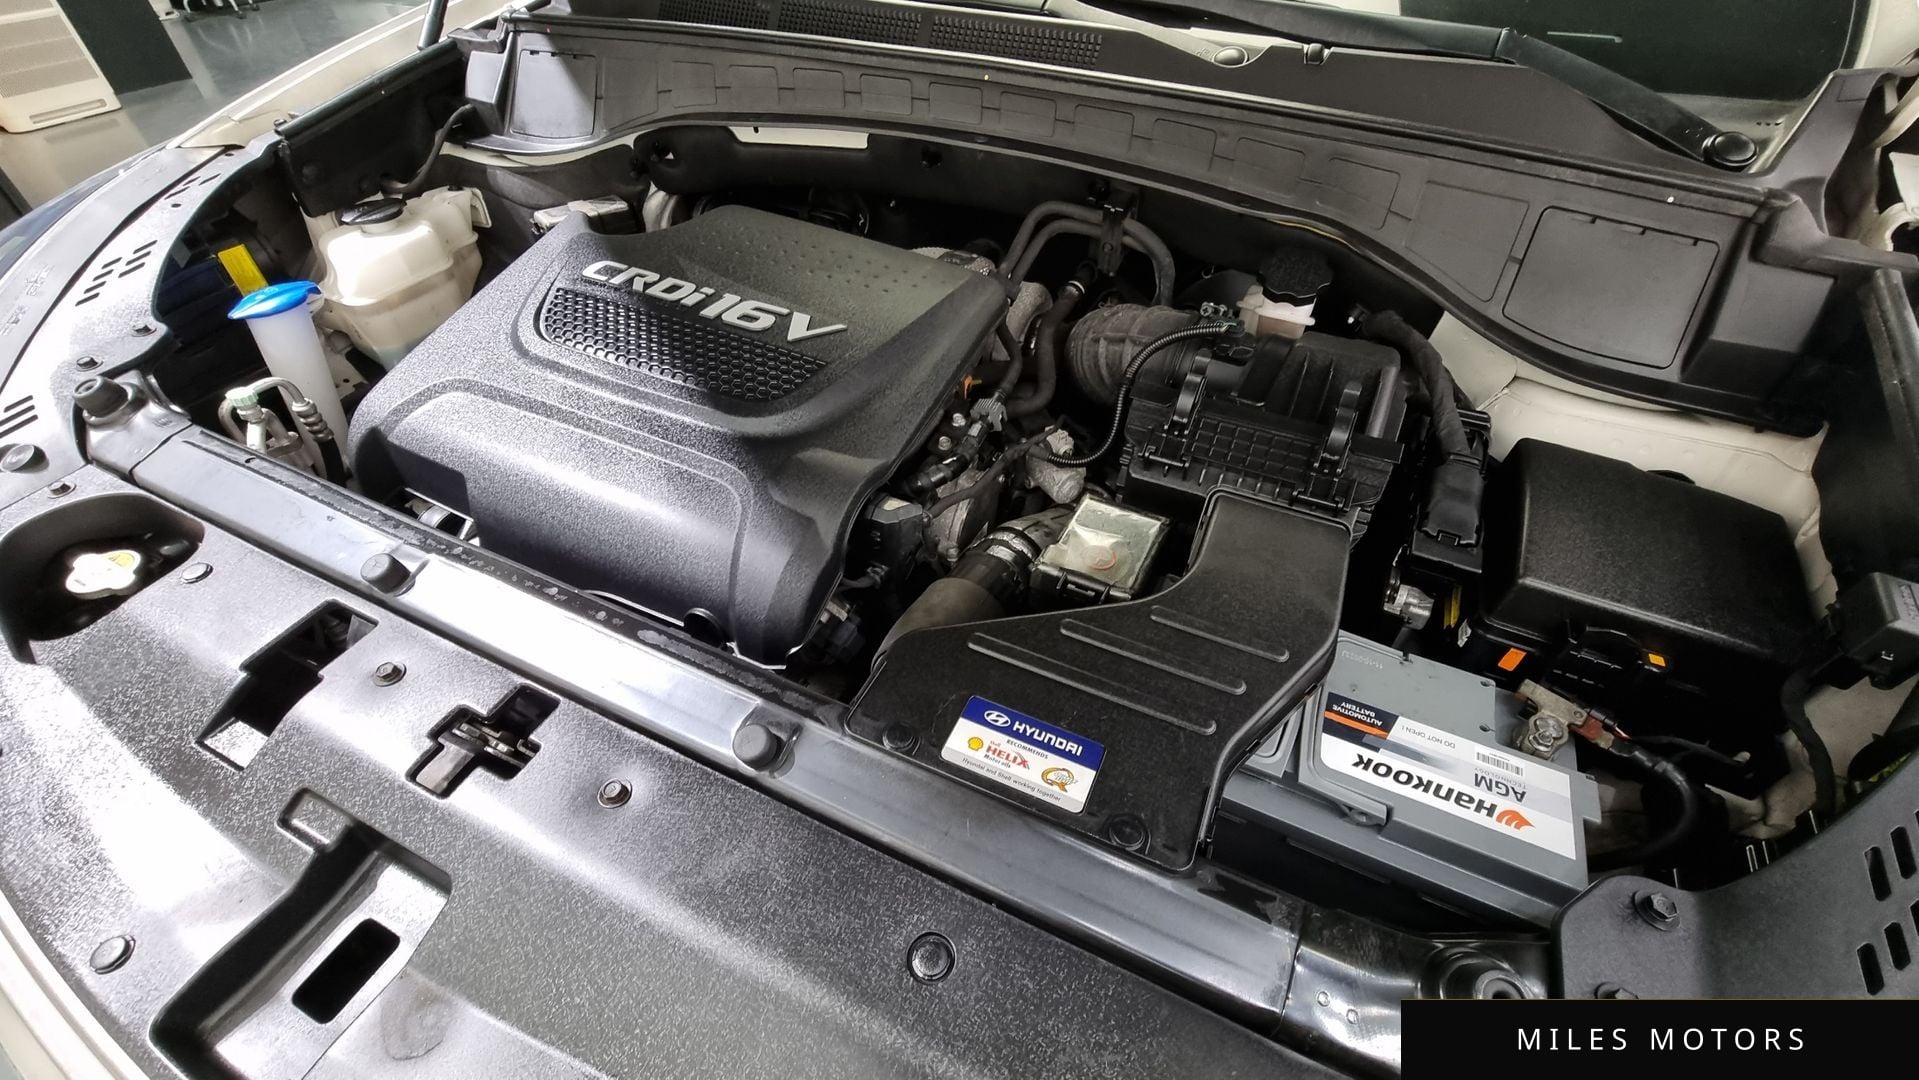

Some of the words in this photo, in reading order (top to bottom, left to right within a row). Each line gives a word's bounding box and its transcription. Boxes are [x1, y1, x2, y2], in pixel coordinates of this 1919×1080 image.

[1332, 704, 1383, 726] AUTOMOTIVE
[1341, 701, 1376, 718] BATTERY
[1006, 739, 1049, 760] RECOMMENDS
[1013, 721, 1083, 756] HYUNDAI
[1427, 734, 1443, 745] NOT
[1443, 740, 1456, 749] DO
[984, 753, 1001, 765] Motor
[986, 745, 1030, 769] HELIX
[962, 756, 985, 772] Hyundai
[986, 767, 997, 776] and
[997, 771, 1012, 782] Shell
[1012, 777, 1036, 793] working
[1036, 787, 1061, 802] together
[1474, 767, 1526, 790] TECHNOLOGY
[1474, 773, 1527, 803] AGM
